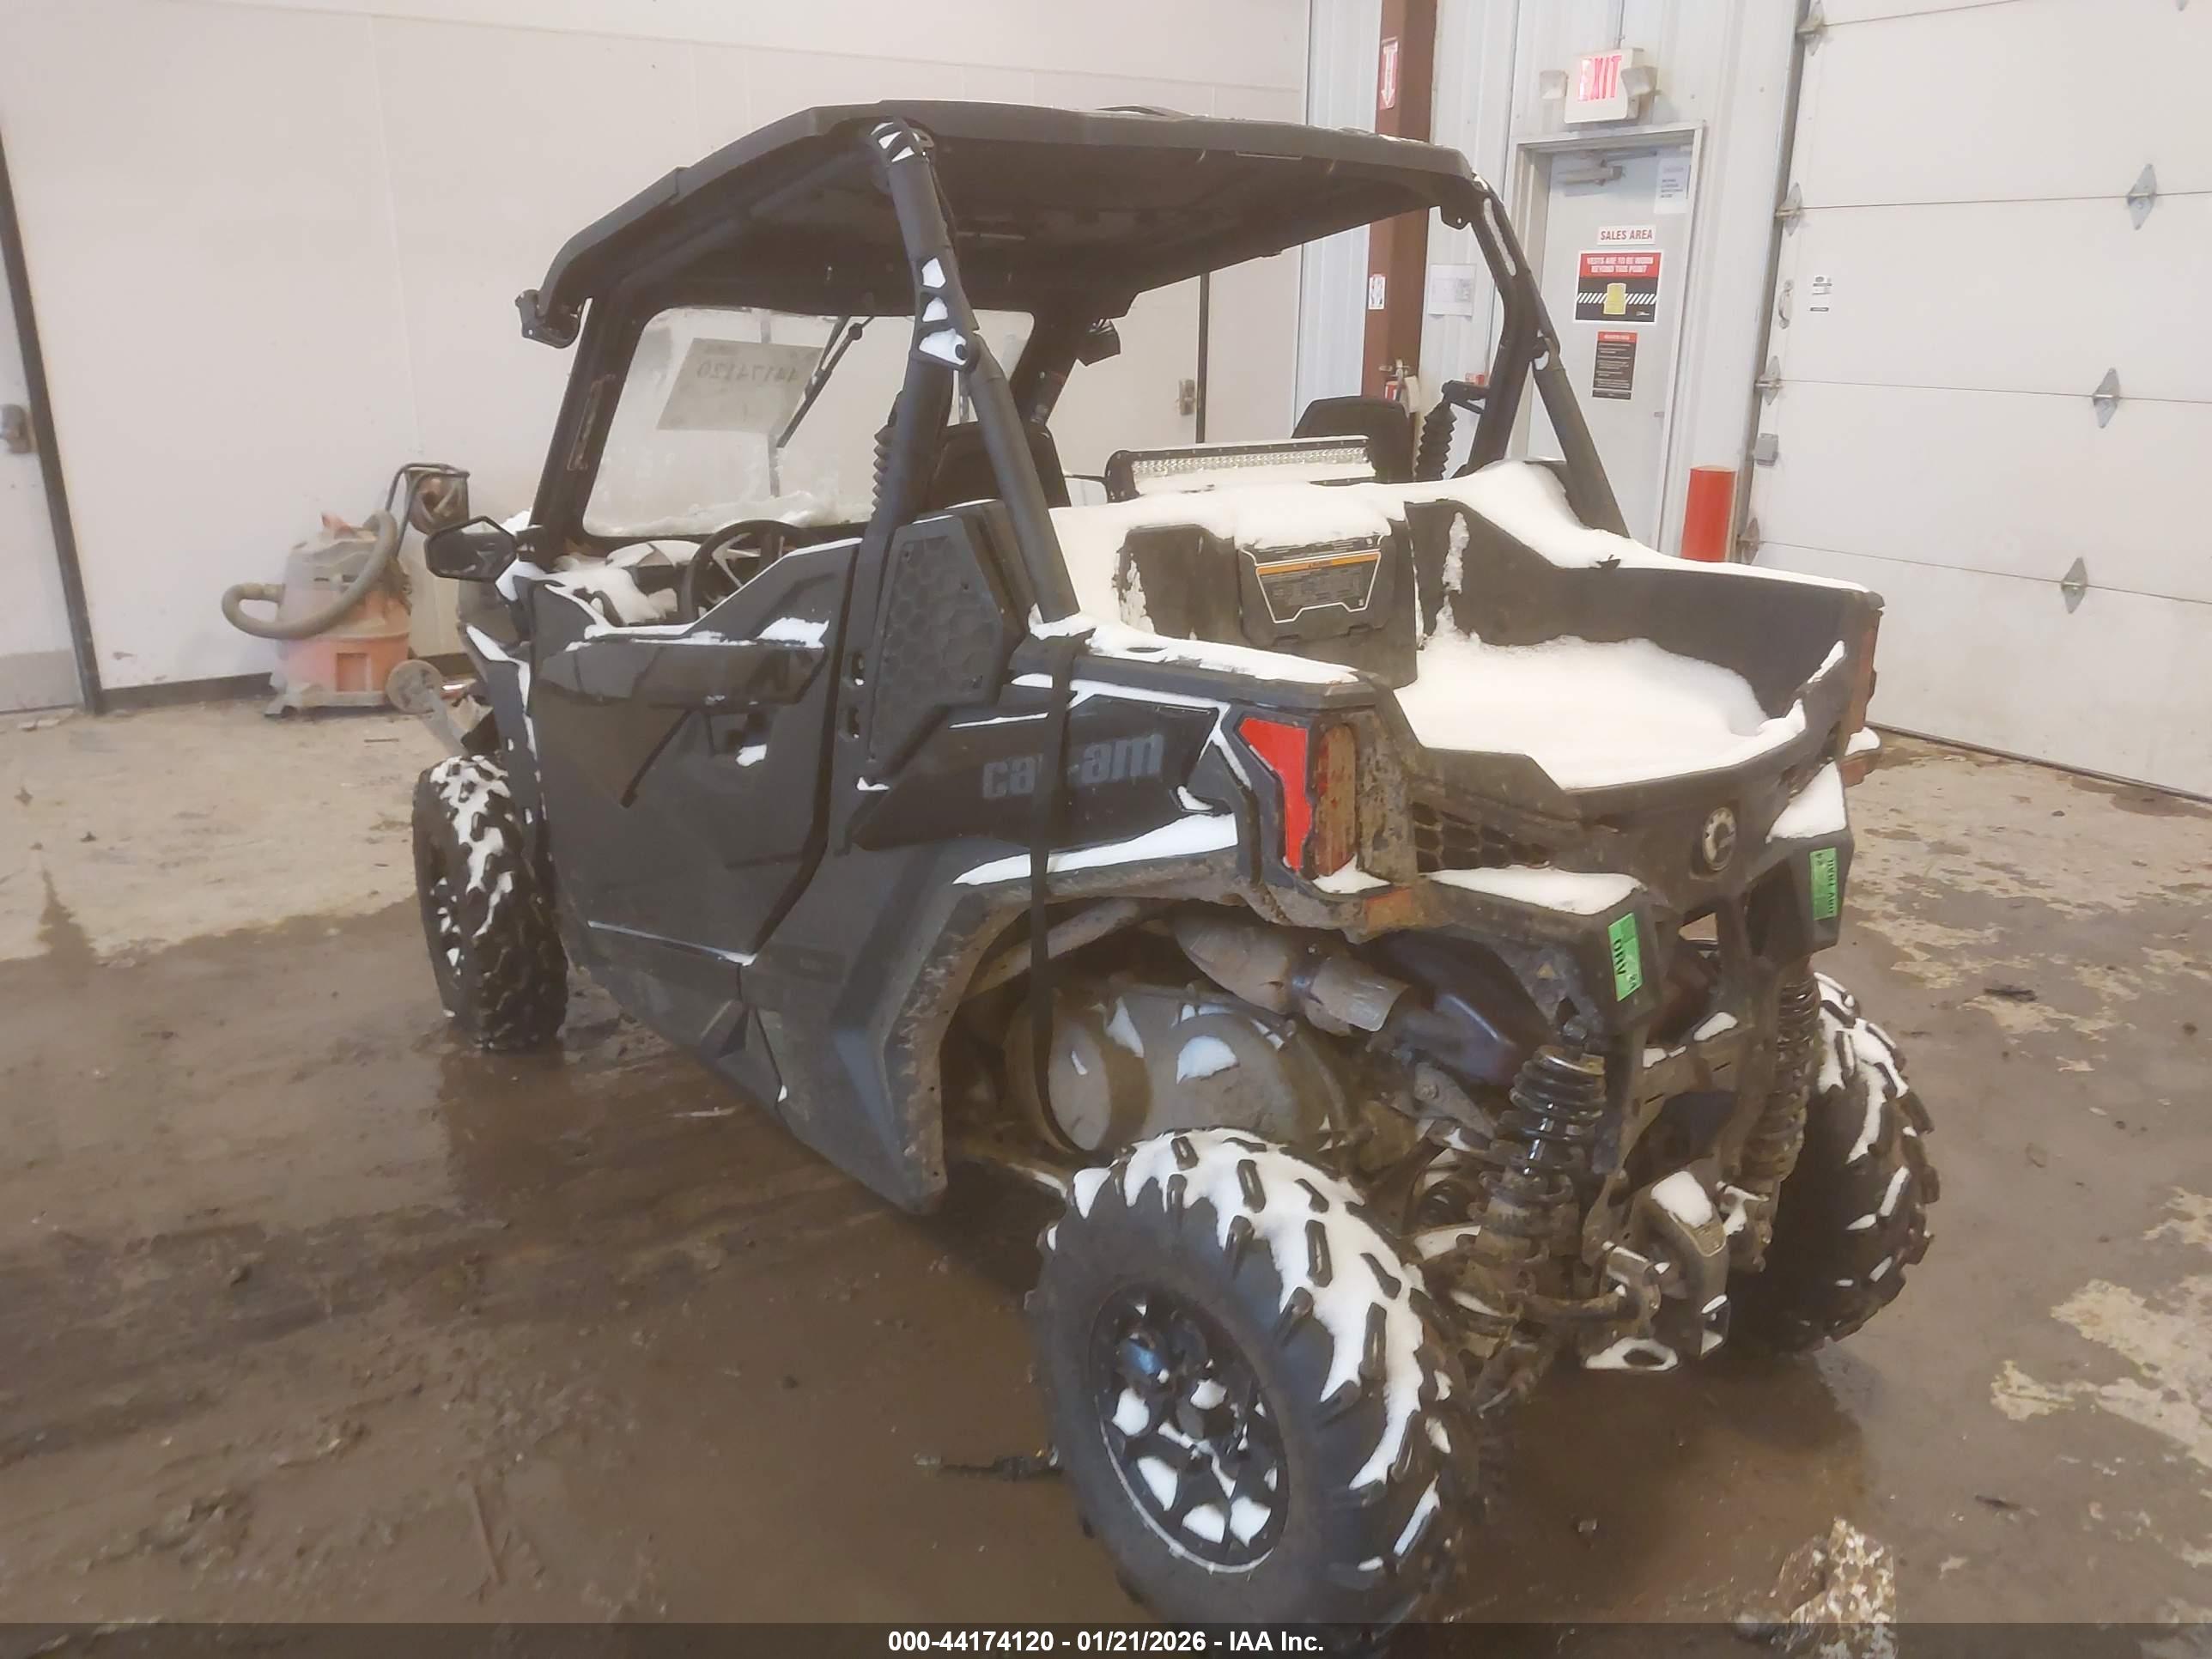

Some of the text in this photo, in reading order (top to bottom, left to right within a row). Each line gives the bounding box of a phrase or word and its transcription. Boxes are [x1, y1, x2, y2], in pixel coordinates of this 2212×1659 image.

[1578, 55, 1622, 102] EXIT
[1601, 229, 1653, 240] SALES AREA
[1613, 938, 1627, 975] ORV
